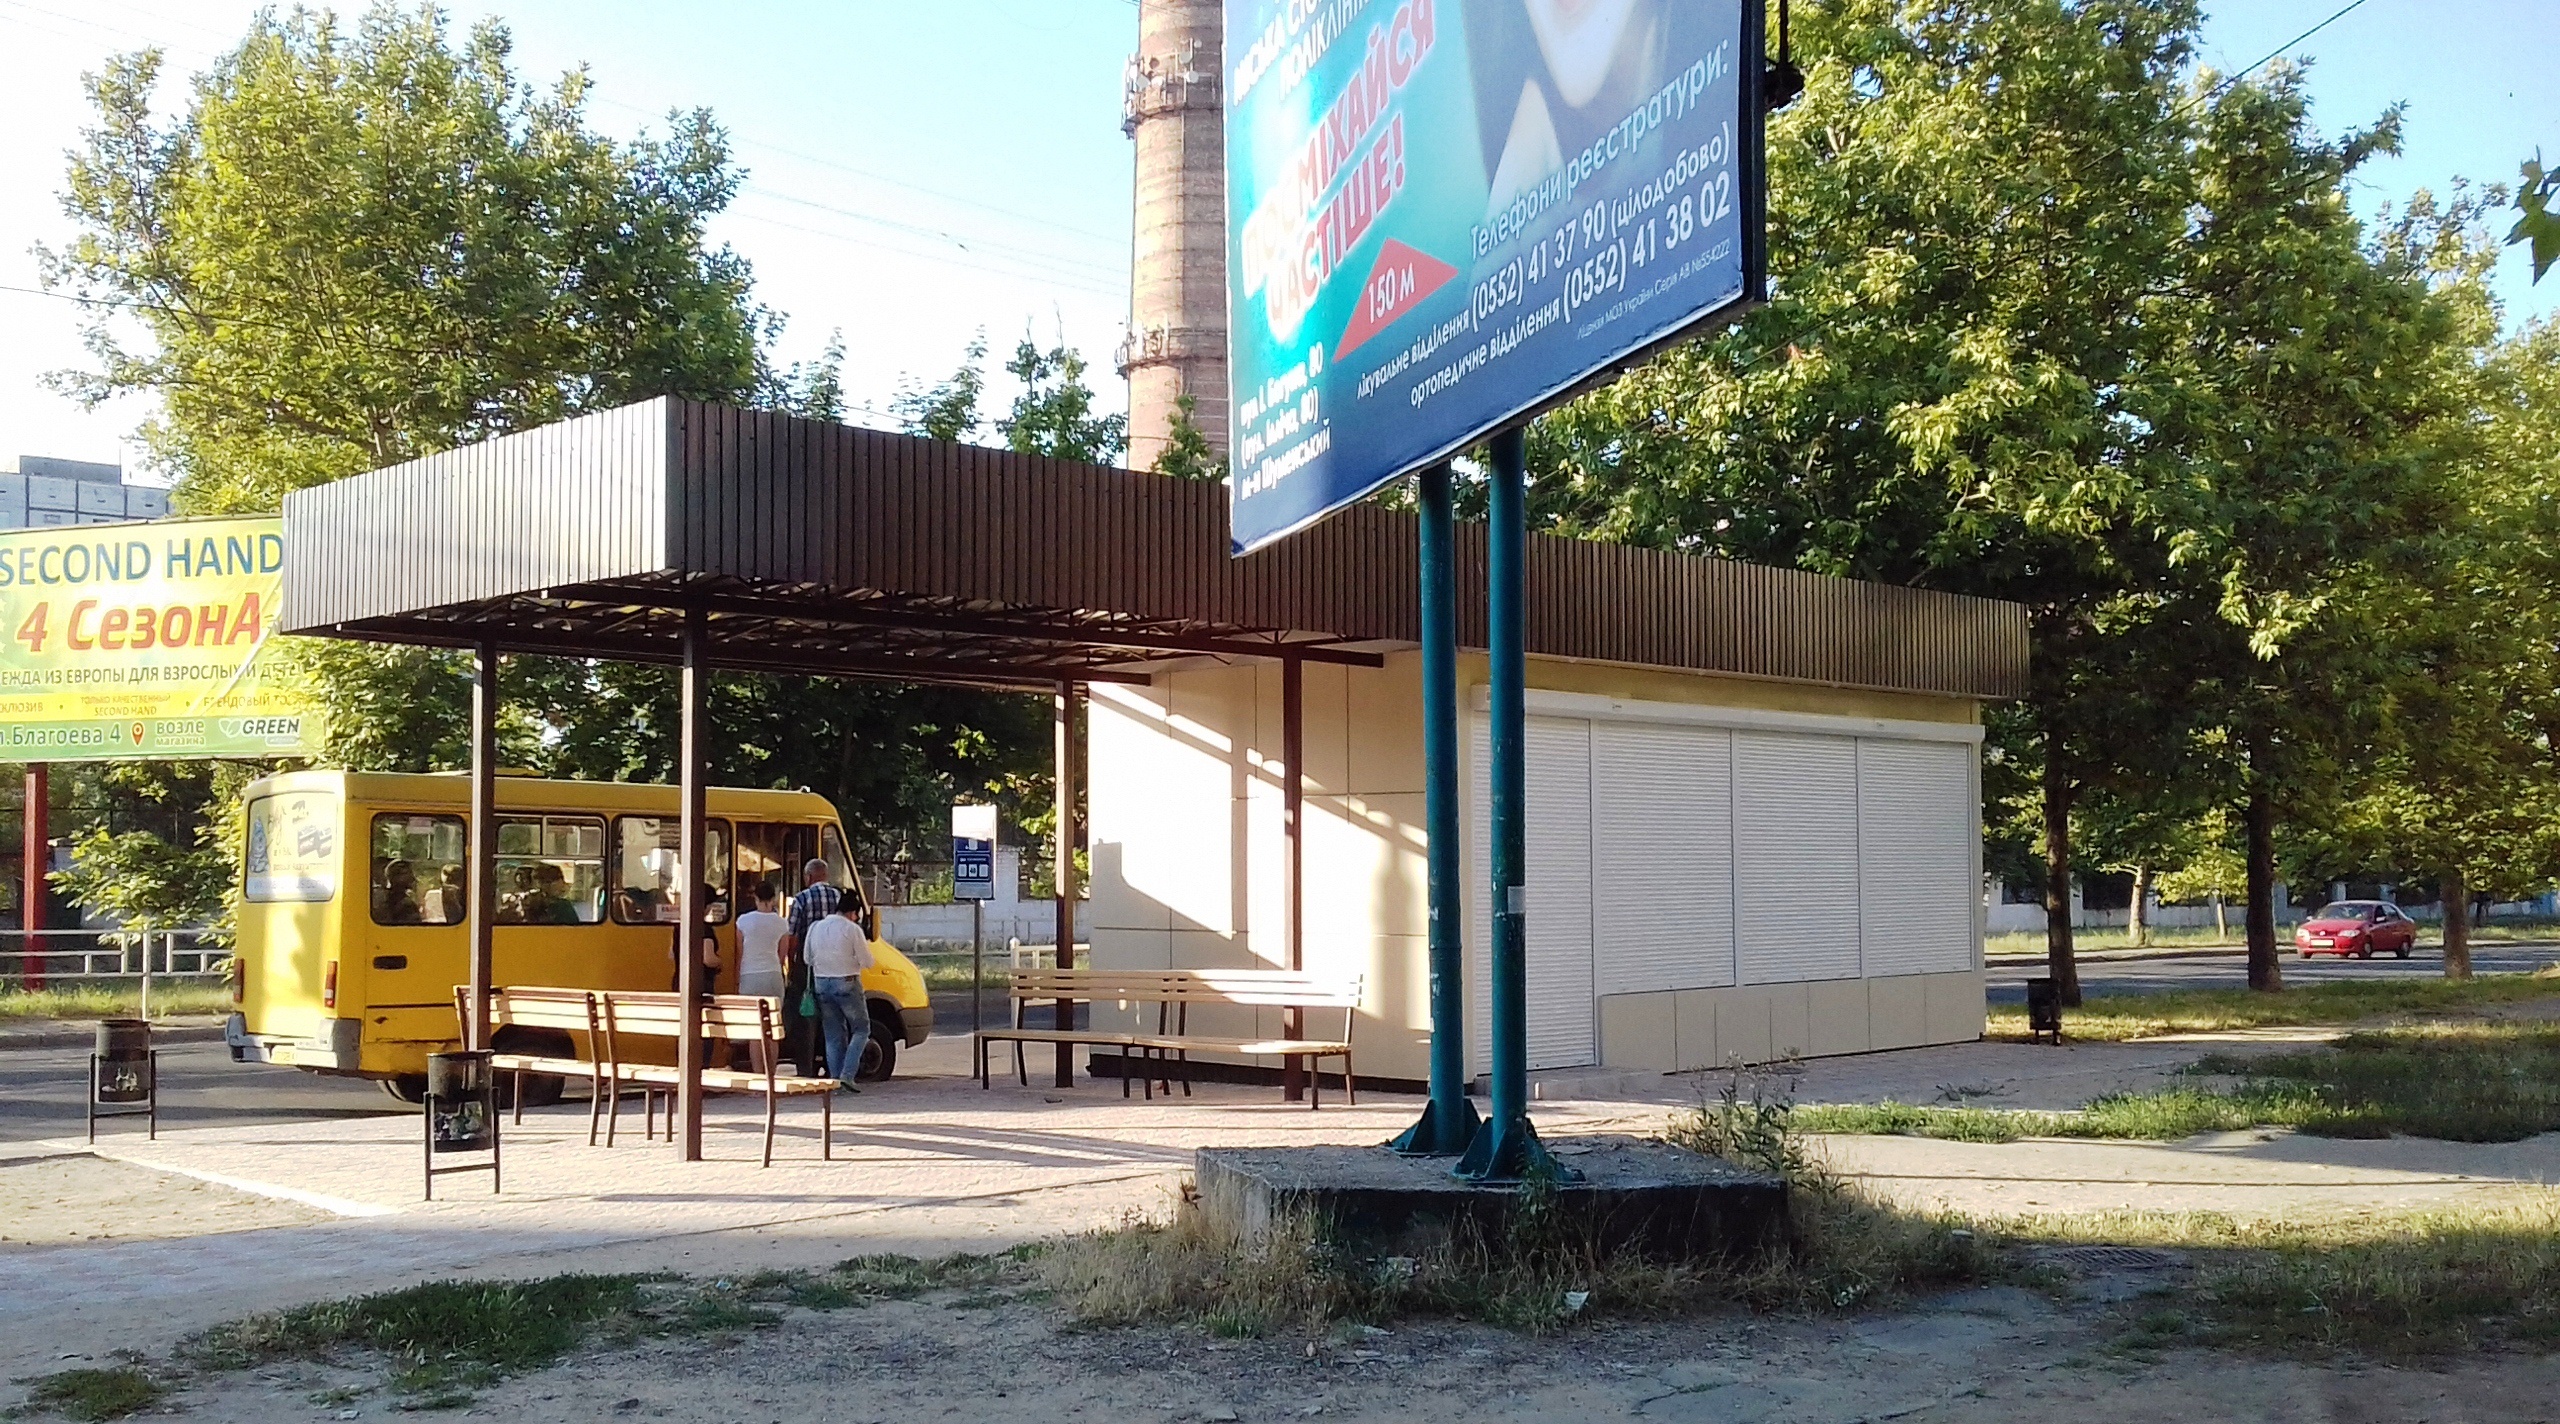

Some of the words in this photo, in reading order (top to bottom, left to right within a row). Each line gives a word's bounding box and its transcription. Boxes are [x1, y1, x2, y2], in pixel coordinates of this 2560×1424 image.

[1470, 171, 1562, 260] Телефони
[1566, 38, 1729, 202] реєстратури:
[1357, 351, 1410, 400] лікувальне
[1412, 309, 1470, 364] відділення
[1472, 256, 1524, 333] (0552)
[1528, 240, 1547, 284] 41
[1554, 218, 1577, 269] 37
[1583, 200, 1606, 249] 90
[1611, 121, 1729, 238] (цілодобово)
[1368, 267, 1396, 323] 150
[1411, 343, 1487, 409] ортопедичне
[1490, 297, 1560, 360] відділення
[1564, 237, 1627, 324] (0552)
[1632, 218, 1656, 268] 41
[1666, 194, 1694, 250] 38
[1700, 170, 1731, 228] 02
[0, 541, 151, 586] SECOND
[166, 533, 283, 578] HAND
[17, 601, 49, 652] 4
[45, 669, 62, 684] ИЗ
[66, 668, 125, 684] ЕВРОПЫ
[128, 667, 159, 685] ДЛЯ
[95, 707, 129, 716] SECOND
[131, 705, 157, 715] HAND
[110, 723, 122, 743] 4
[156, 720, 205, 735] возле
[242, 718, 300, 735] GREEN
